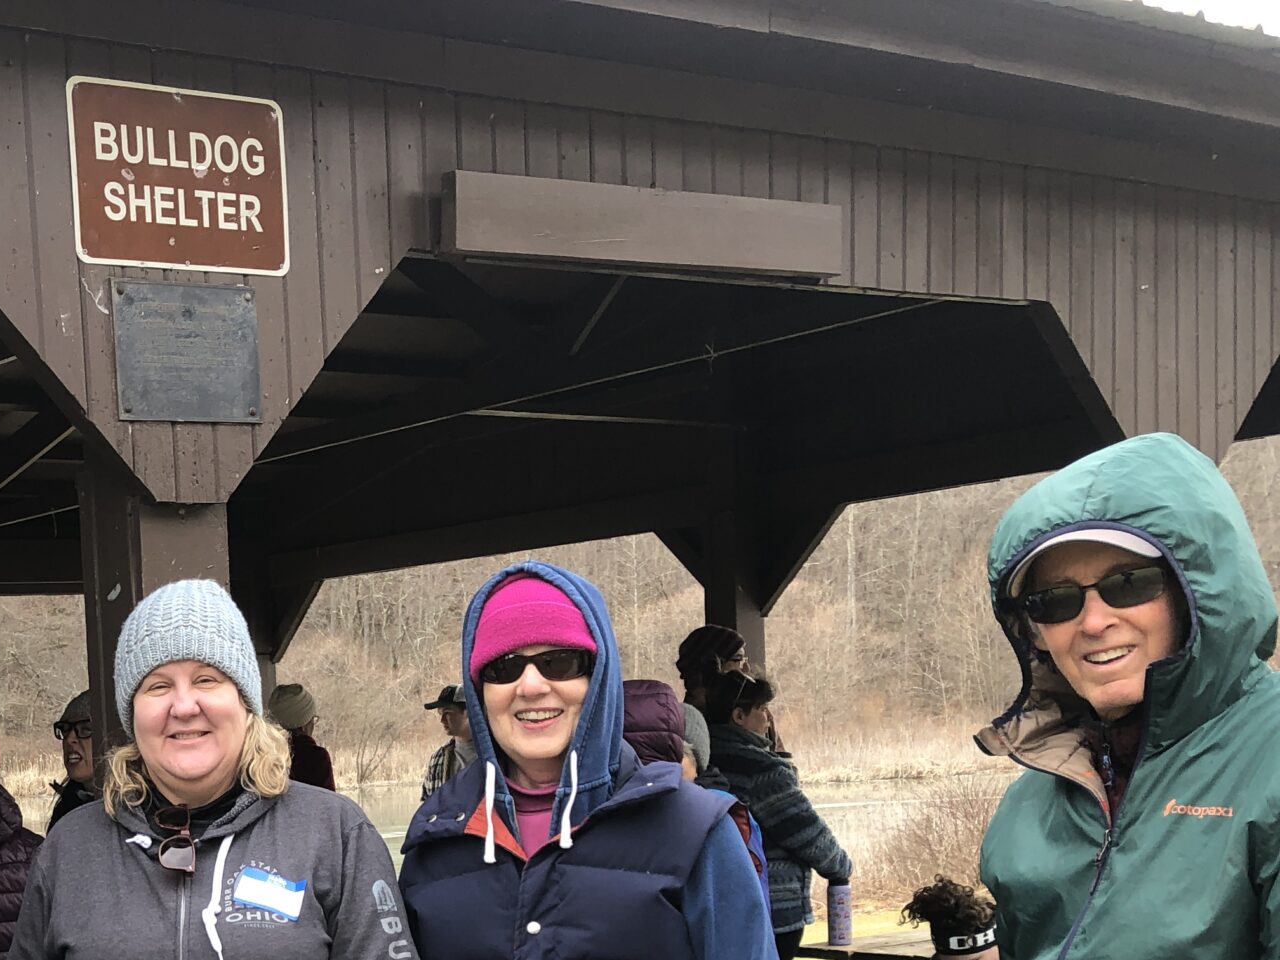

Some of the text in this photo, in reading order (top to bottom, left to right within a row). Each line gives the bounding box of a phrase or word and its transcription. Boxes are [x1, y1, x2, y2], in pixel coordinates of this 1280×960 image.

[93, 121, 266, 176] BULLDOG
[103, 181, 264, 233] SHELTER
[1171, 803, 1234, 819] cotopaxi
[250, 860, 278, 874] STAT
[225, 911, 289, 923] OHIO
[949, 923, 997, 950] CH
